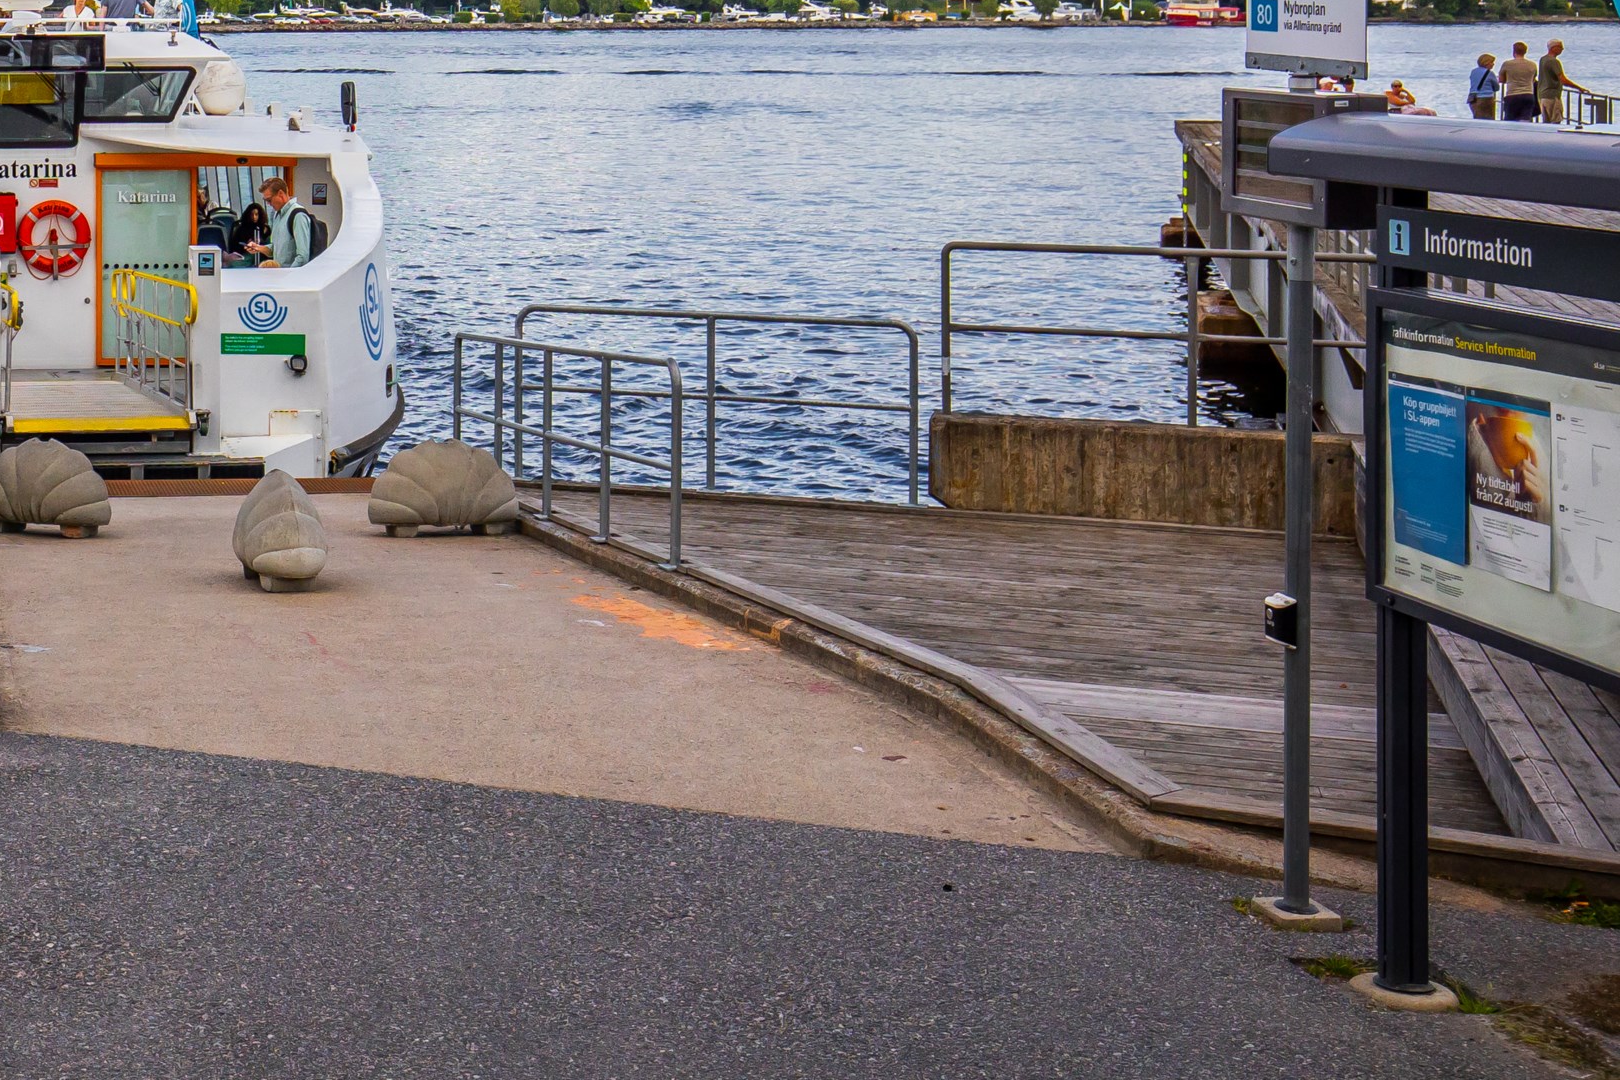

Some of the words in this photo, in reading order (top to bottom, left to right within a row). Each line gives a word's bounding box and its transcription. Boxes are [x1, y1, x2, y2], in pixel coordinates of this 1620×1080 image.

[1256, 4, 1273, 25] 80
[1283, 0, 1326, 18] Nybroplan
[1284, 21, 1292, 30] via
[1293, 20, 1322, 32] Allmänna
[1323, 21, 1342, 34] gränd
[118, 190, 177, 203] Katarina
[1424, 227, 1532, 267] Information
[254, 301, 272, 314] SL
[368, 282, 378, 314] SL
[1392, 325, 1454, 347] rafikinformation
[1455, 337, 1484, 353] Service
[1485, 342, 1537, 361] Information
[1403, 395, 1417, 409] Köp
[1418, 401, 1457, 418] gruppbiljett
[1408, 410, 1440, 427] SL-appen
[1476, 472, 1487, 487] Ny
[1488, 476, 1520, 494] tidtabell
[1476, 488, 1492, 503] från
[1493, 492, 1503, 506] 22
[1504, 499, 1533, 513] augusti
